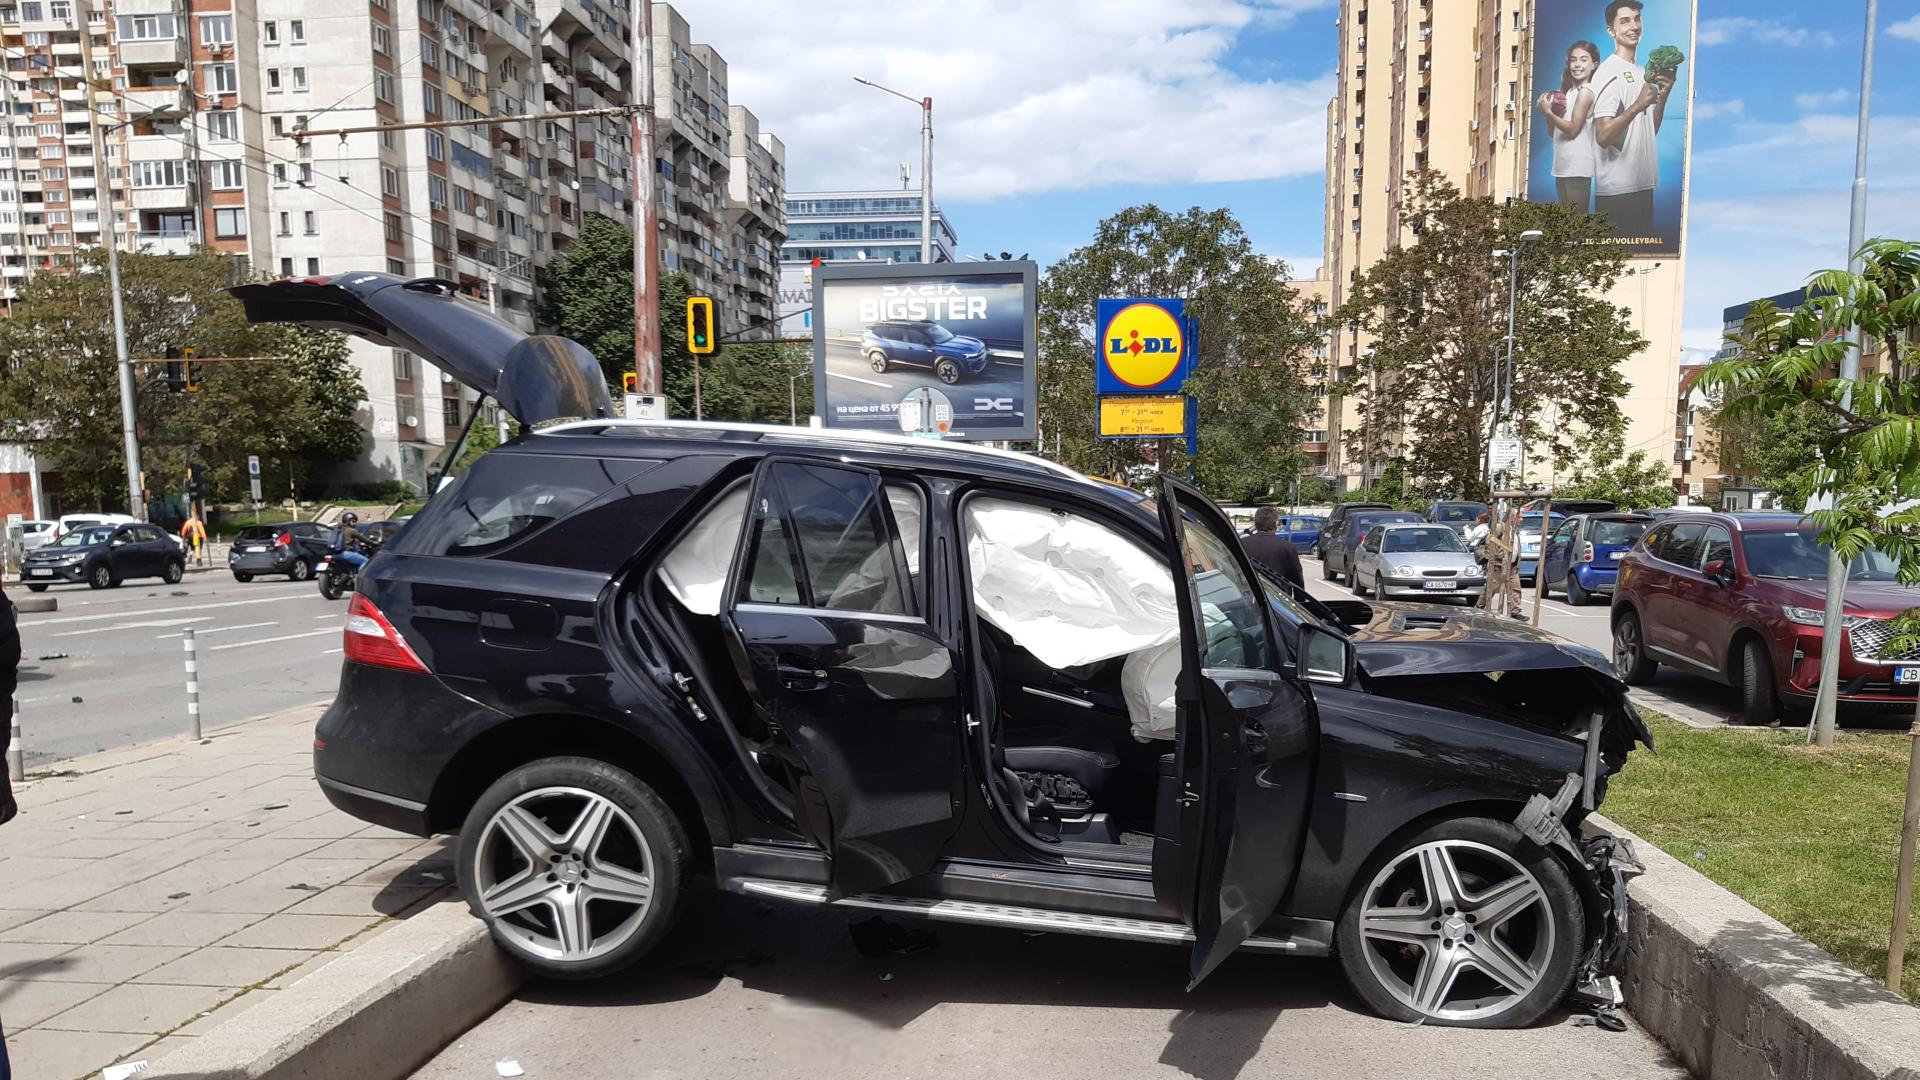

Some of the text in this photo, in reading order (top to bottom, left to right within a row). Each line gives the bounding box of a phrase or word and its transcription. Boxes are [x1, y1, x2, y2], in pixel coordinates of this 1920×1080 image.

[883, 286, 961, 296] DACIA
[860, 296, 987, 321] BIGSTER
[836, 406, 847, 414] на
[848, 405, 868, 414] цена
[880, 404, 891, 412] 45
[1903, 669, 1918, 680] CB
